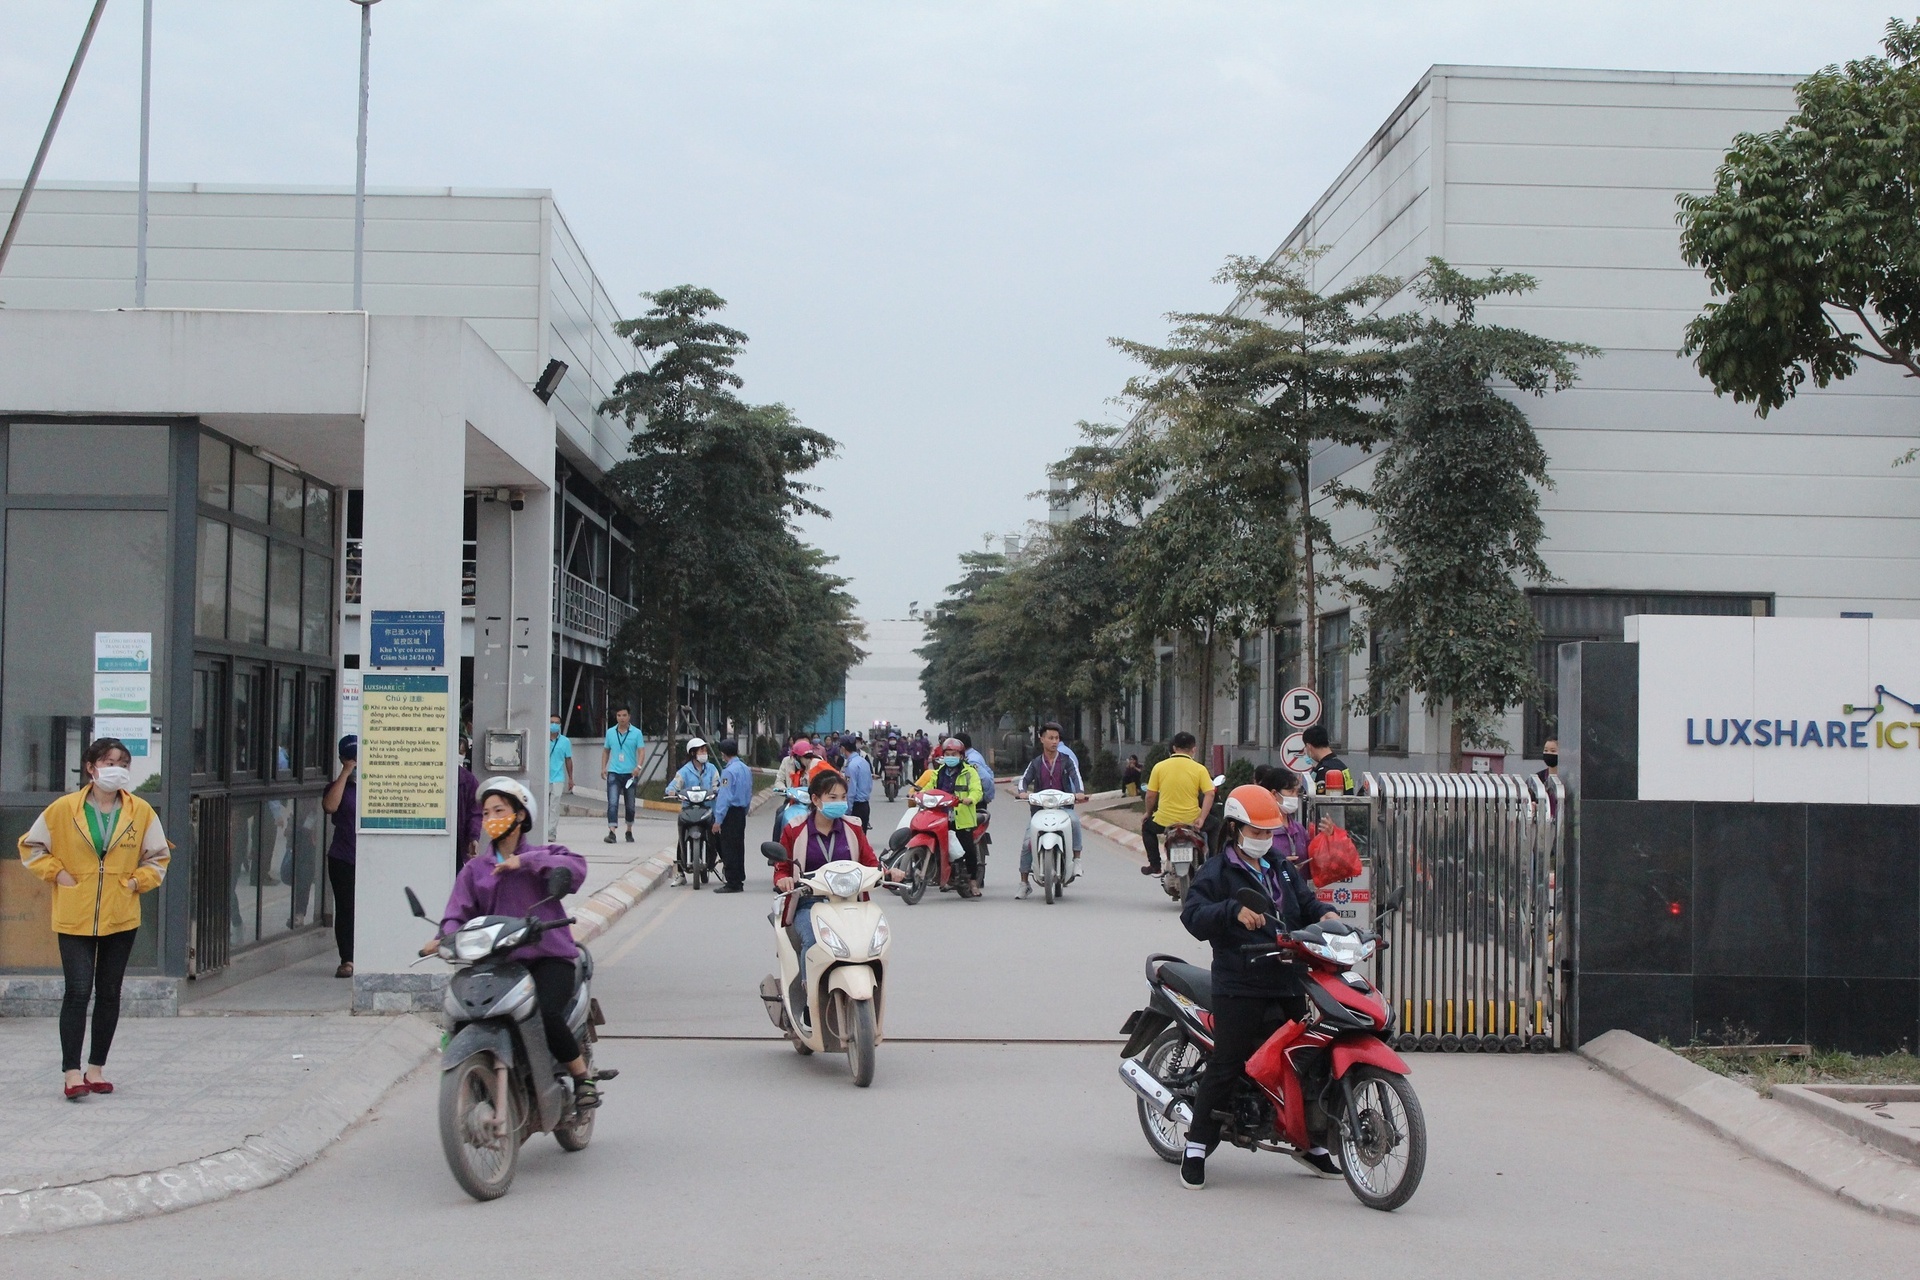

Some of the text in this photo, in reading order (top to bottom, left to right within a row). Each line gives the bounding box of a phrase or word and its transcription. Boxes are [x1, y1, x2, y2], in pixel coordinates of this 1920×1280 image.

[385, 694, 401, 702] Chú
[402, 695, 408, 703] ý
[1293, 695, 1311, 721] 5
[1687, 718, 1868, 748] LUXSHARE
